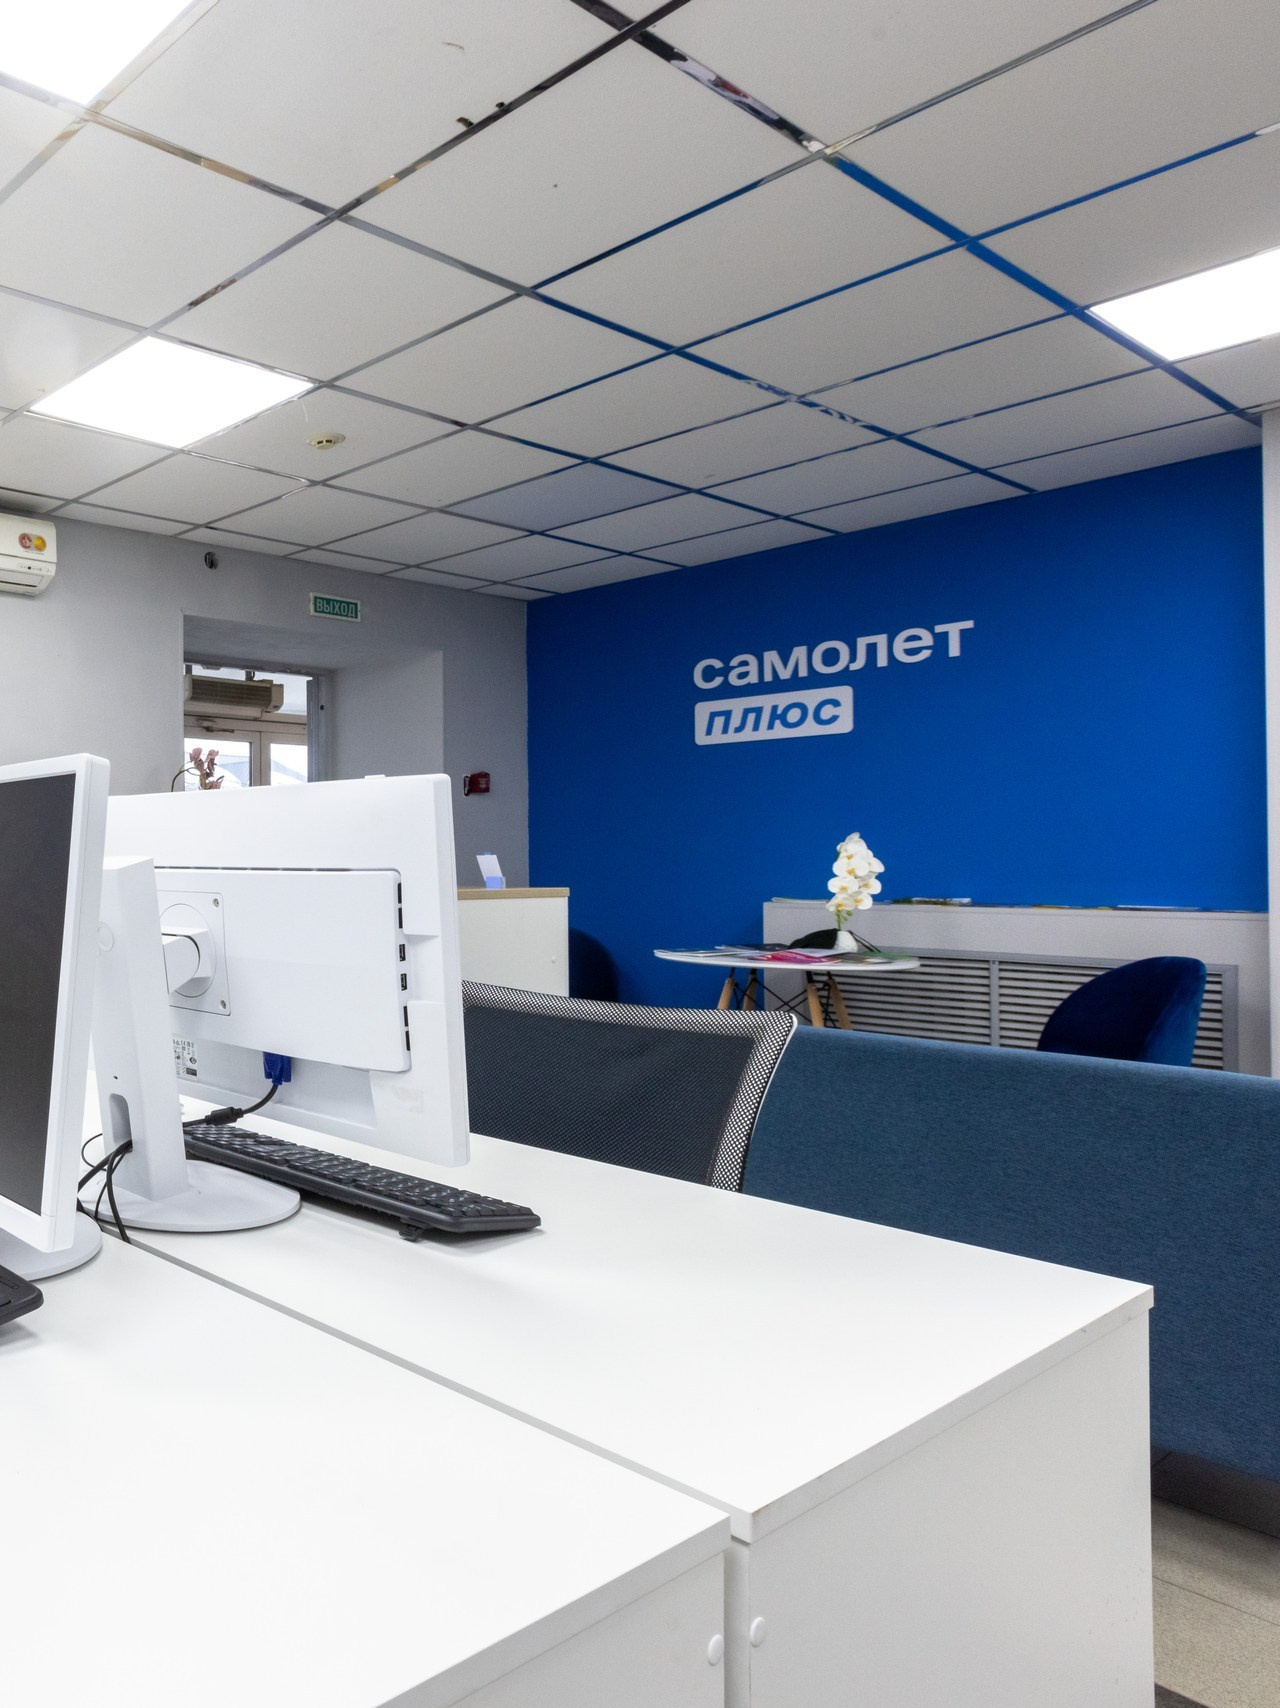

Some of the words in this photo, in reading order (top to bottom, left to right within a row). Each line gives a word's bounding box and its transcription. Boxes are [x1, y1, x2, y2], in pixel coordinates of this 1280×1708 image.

[316, 598, 356, 617] ВЫХОД
[693, 619, 974, 689] самолет
[705, 698, 842, 736] плюс
